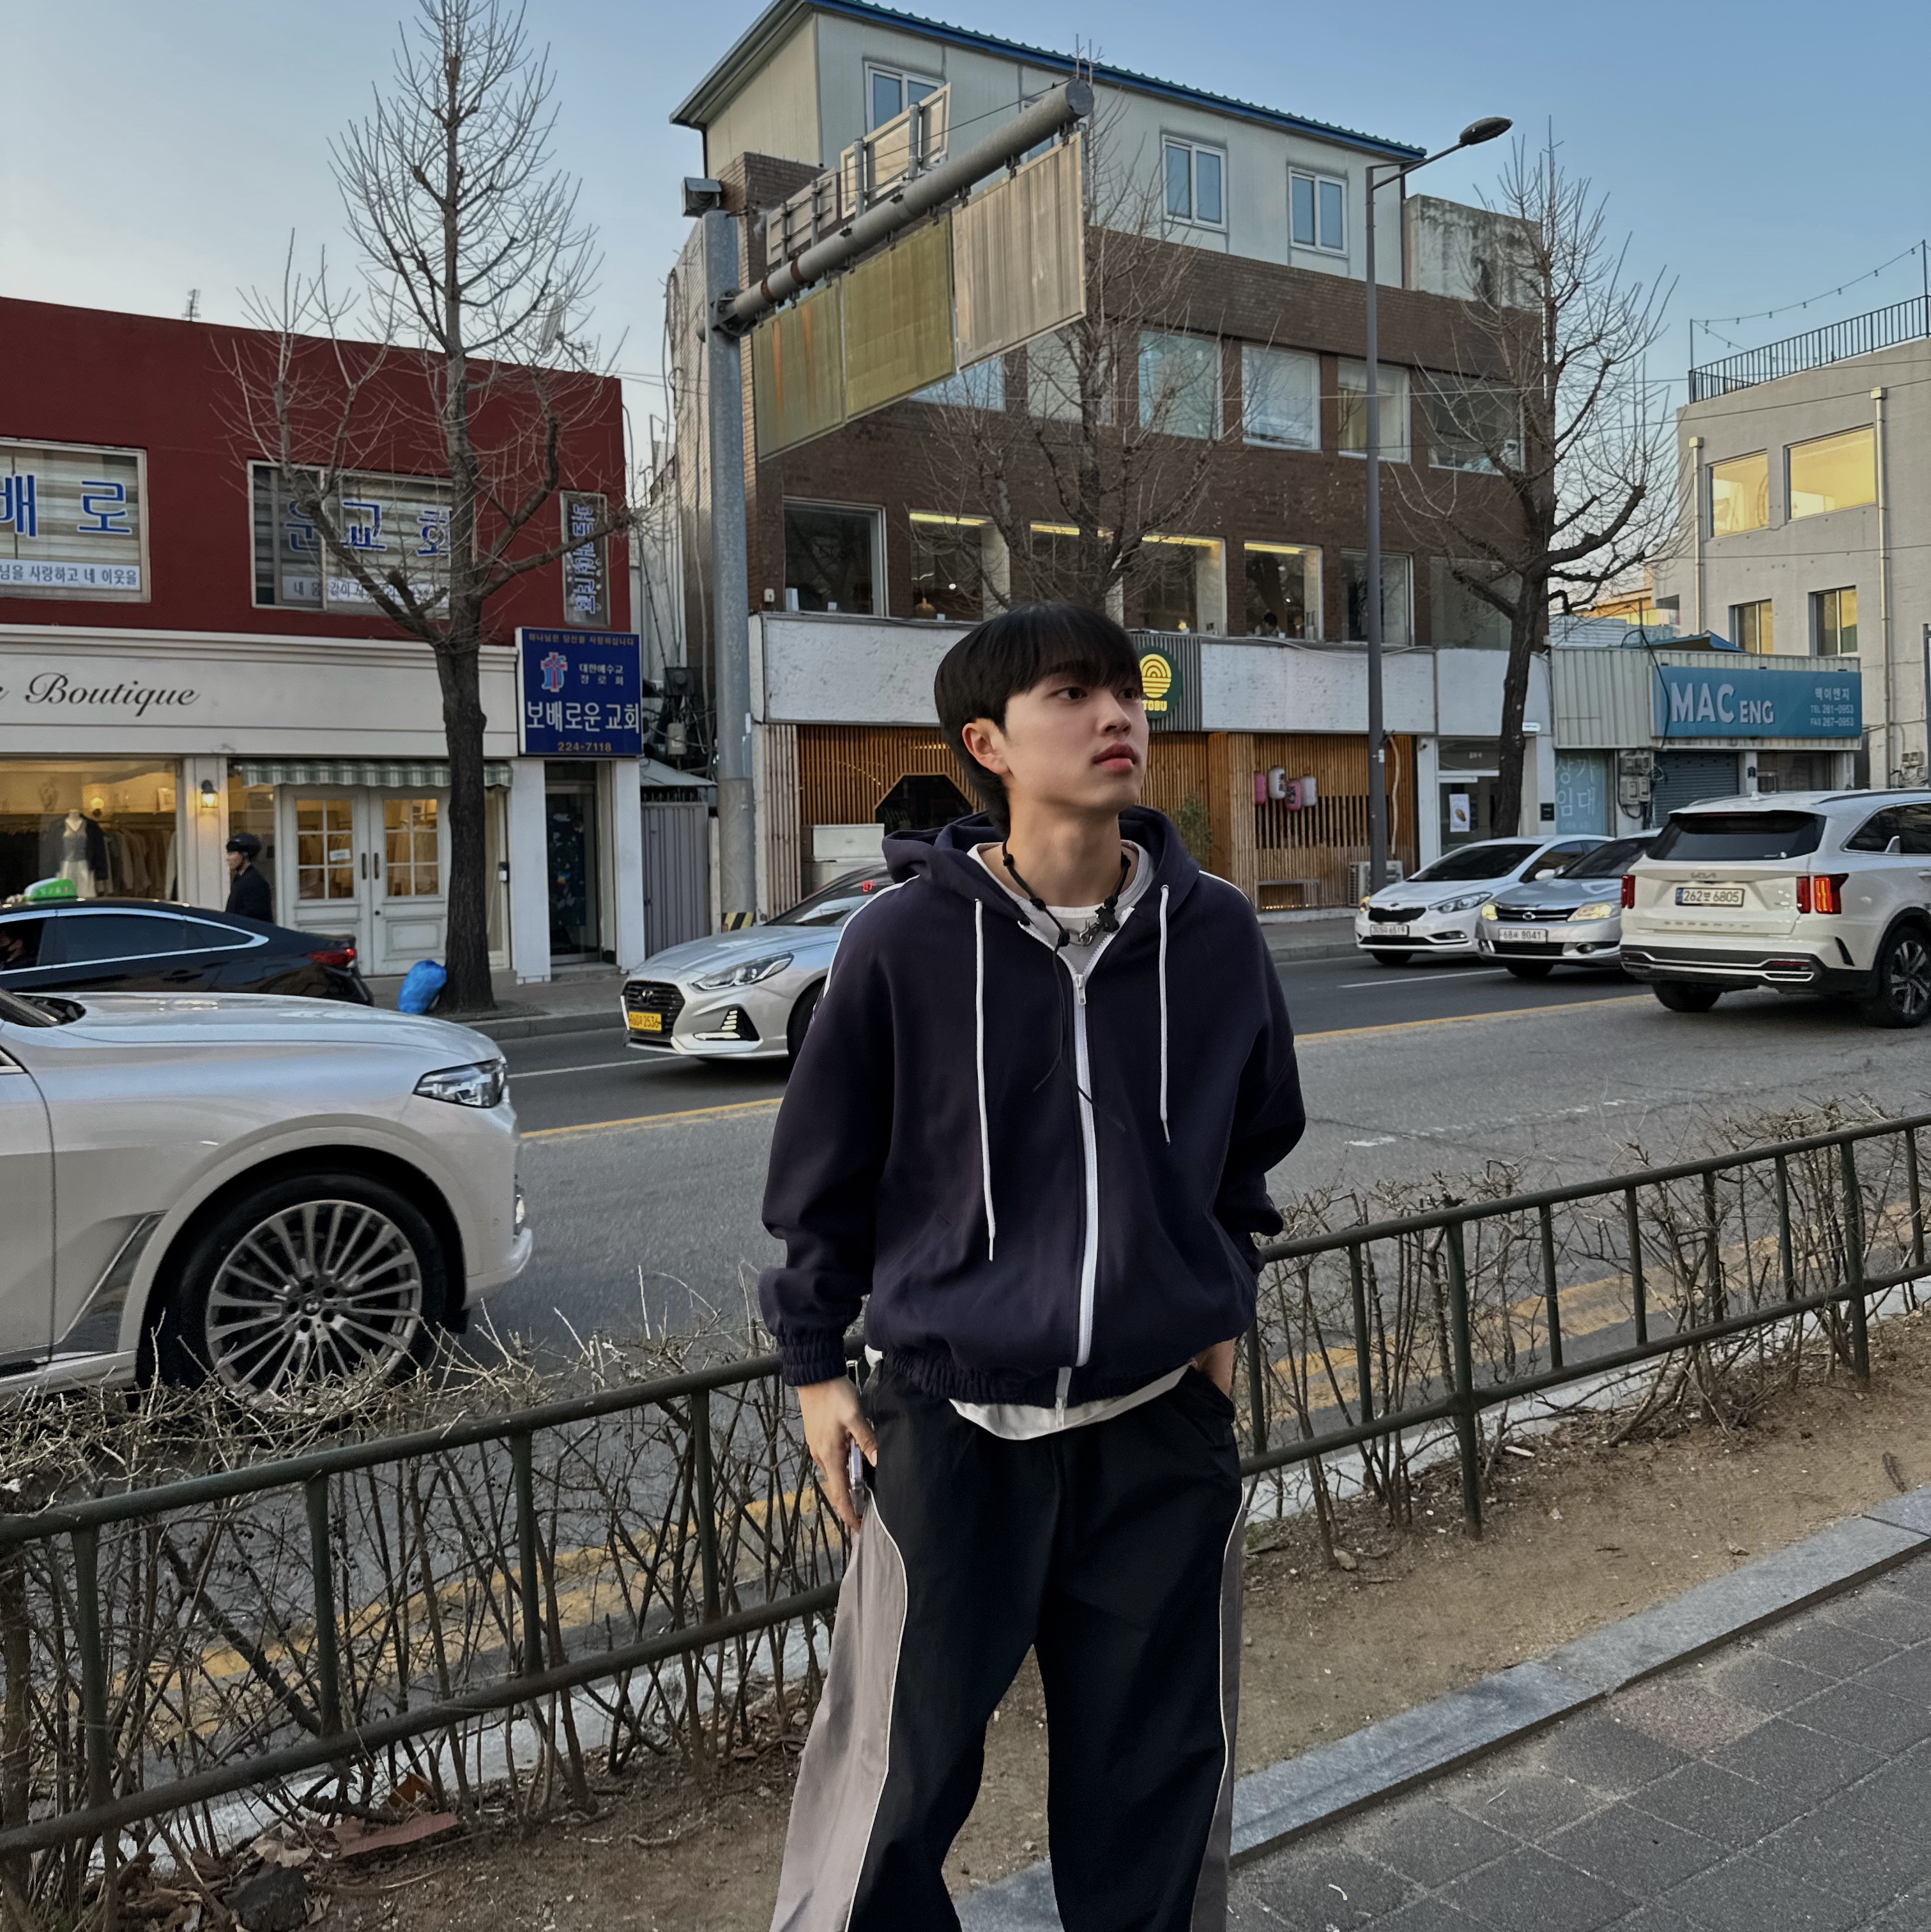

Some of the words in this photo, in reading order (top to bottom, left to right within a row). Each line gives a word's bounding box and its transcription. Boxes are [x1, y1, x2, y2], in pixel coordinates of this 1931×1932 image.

[30, 566, 79, 583] 사랑하고
[102, 569, 137, 586] 이웃을
[579, 663, 623, 674] 대한예수교
[25, 672, 200, 717] Boutique
[1670, 681, 1735, 724] MAC
[1739, 699, 1775, 724] ENG
[1142, 699, 1168, 711] TOBU
[1810, 704, 1820, 713] TEL
[527, 701, 601, 733] 보배로운
[605, 702, 639, 734] 교회
[1810, 717, 1821, 726] FAX
[558, 741, 612, 752] 224-7118
[1555, 755, 1598, 784] 상가
[1557, 786, 1595, 816] 임대
[1713, 891, 1739, 902] 6805
